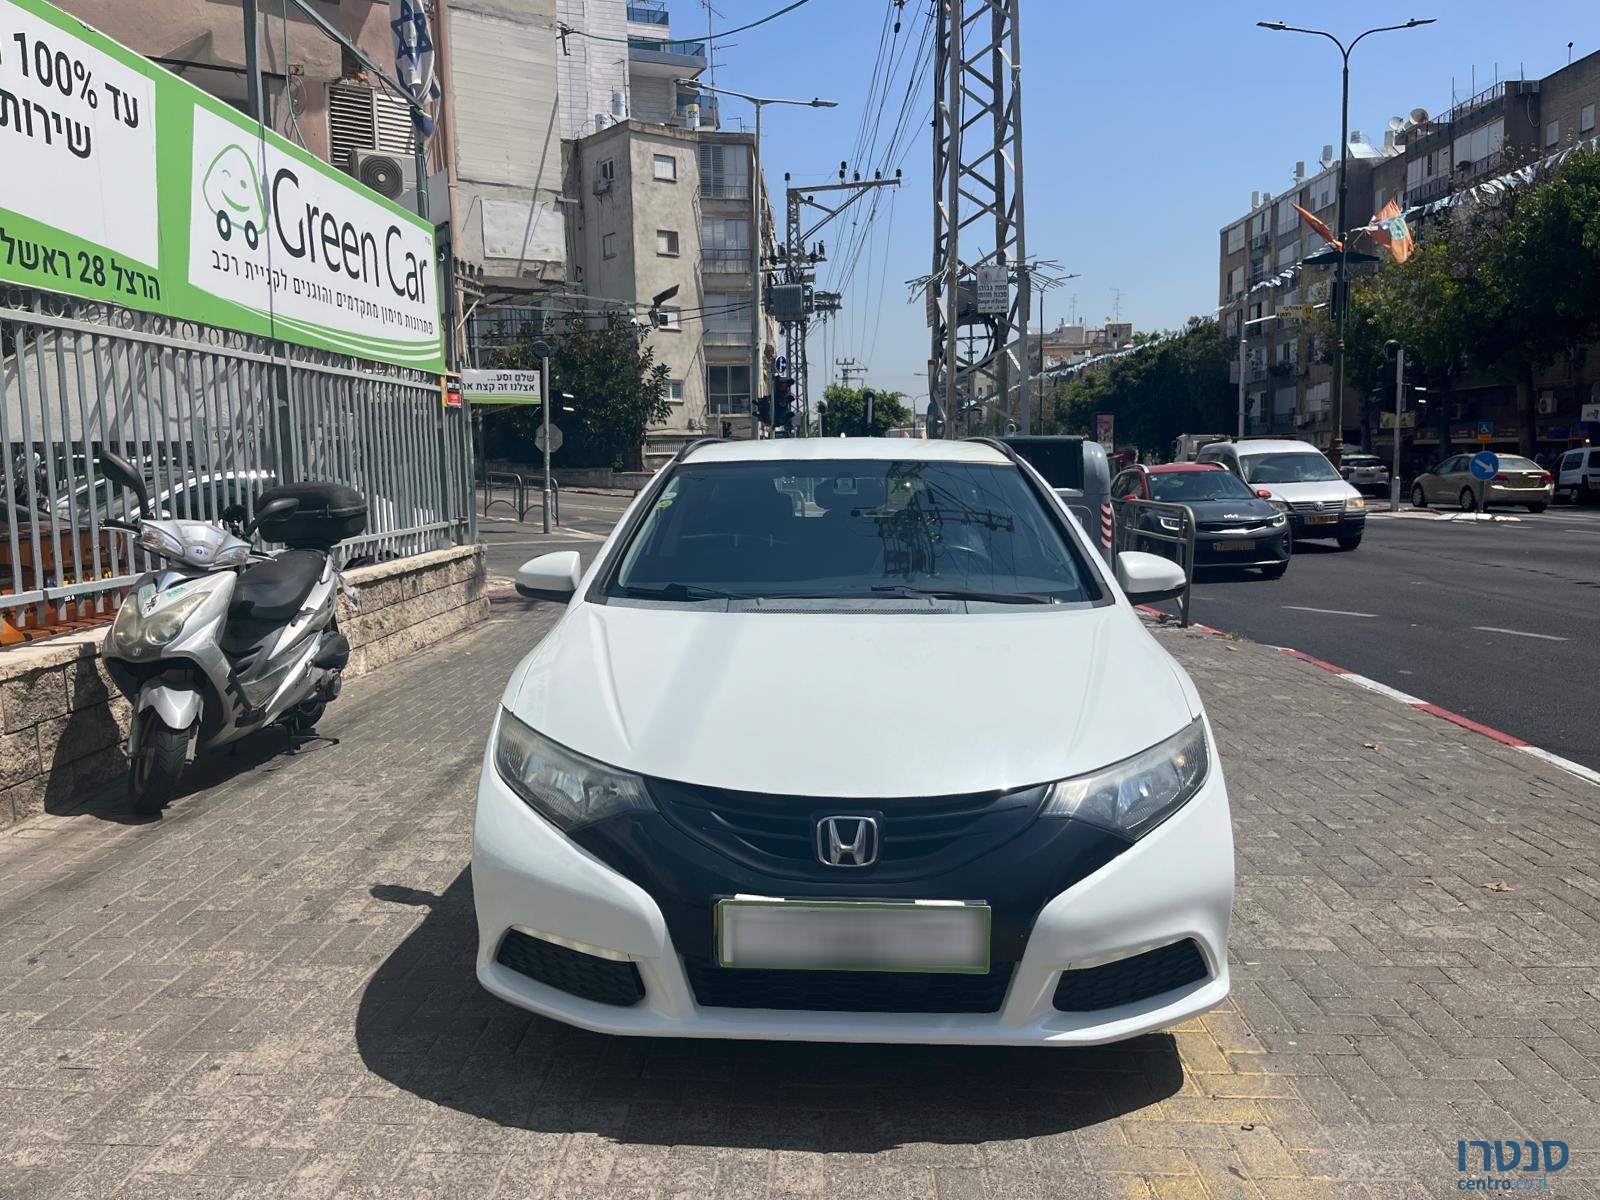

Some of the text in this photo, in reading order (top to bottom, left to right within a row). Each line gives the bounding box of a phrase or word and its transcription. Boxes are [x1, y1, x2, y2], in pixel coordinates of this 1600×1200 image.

[13, 32, 98, 110] 100%
[104, 82, 139, 129] עד
[272, 168, 428, 305] Green Car
[0, 226, 161, 301] הרצל 28 ראשל
[211, 249, 434, 335] פתרונות מימון מתקדמים והוגנים לקניית רכב
[475, 383, 495, 393] קצת
[497, 383, 508, 391] זה
[510, 382, 535, 392] אצלנו
[514, 373, 535, 382] שלם
